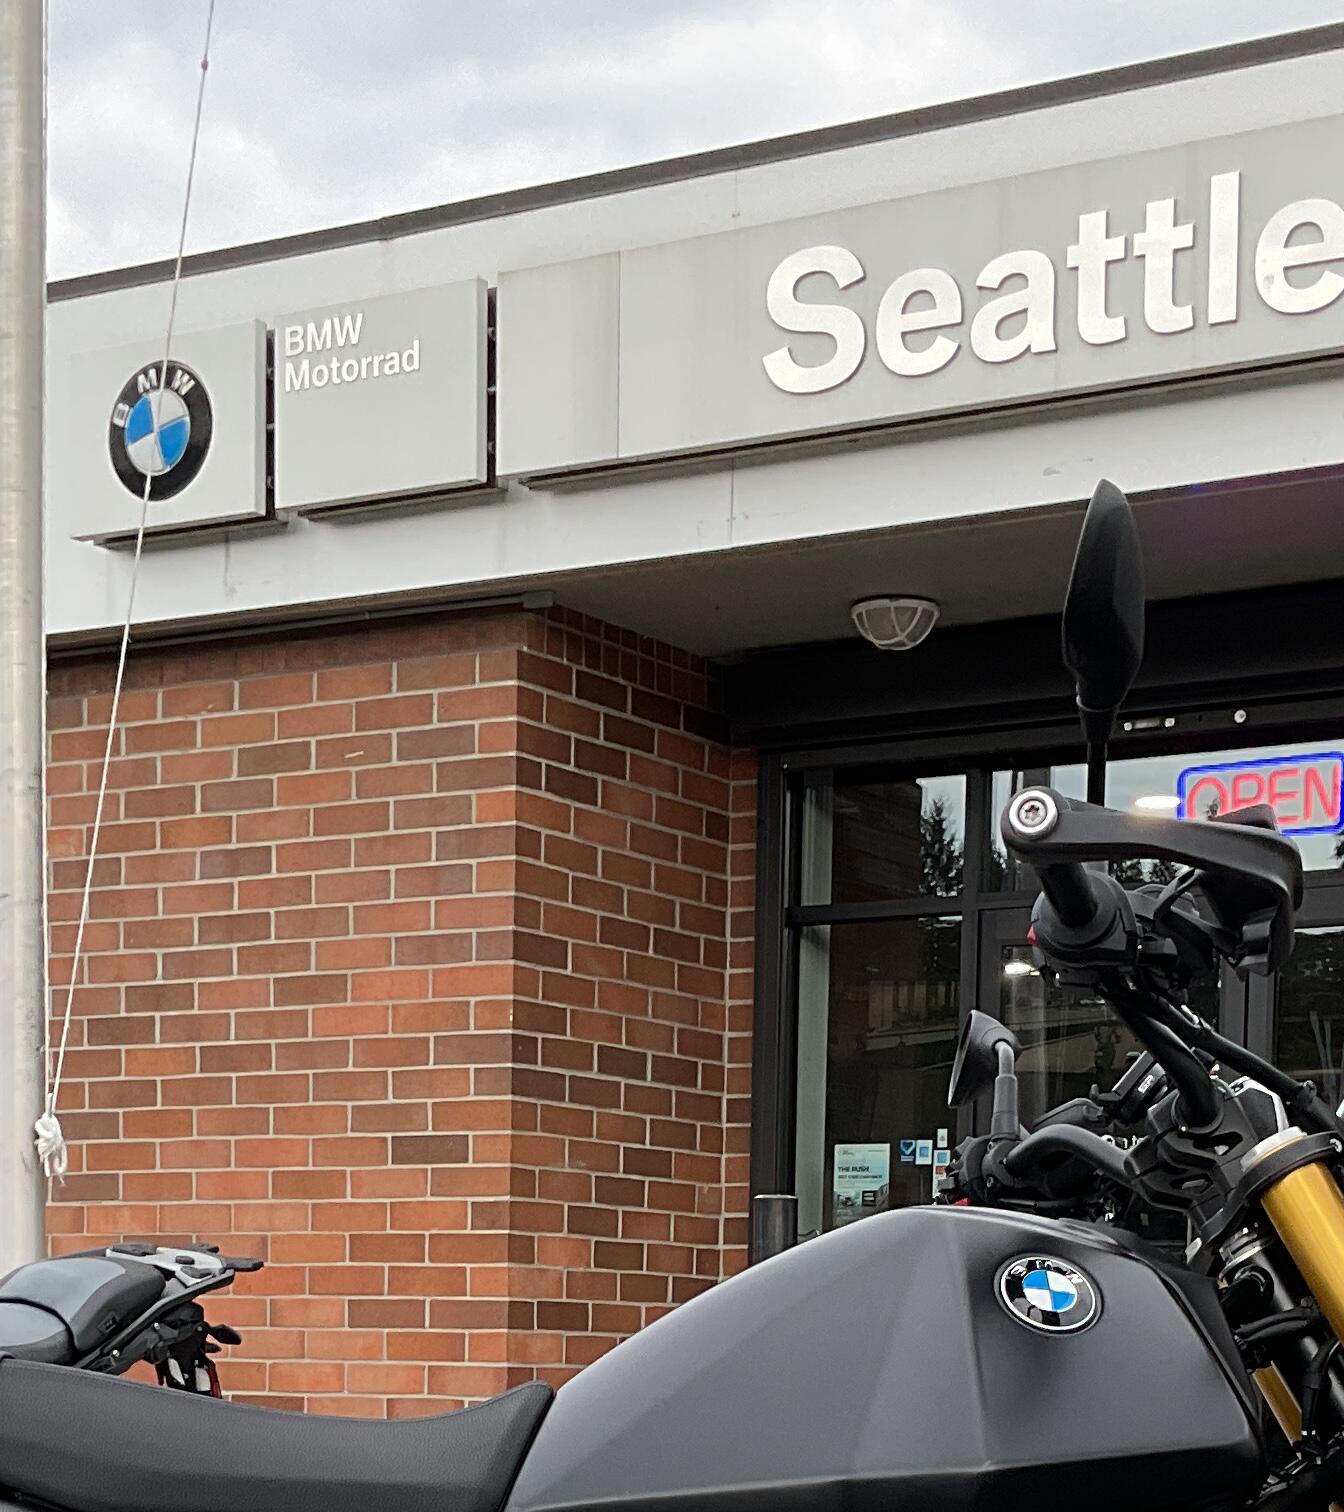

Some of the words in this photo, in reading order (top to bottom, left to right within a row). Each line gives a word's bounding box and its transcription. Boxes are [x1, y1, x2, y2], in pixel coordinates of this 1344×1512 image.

[284, 312, 364, 357] BMW
[284, 340, 421, 393] Motorrad
[112, 367, 196, 429] BMW
[1186, 763, 1342, 824] OPEN
